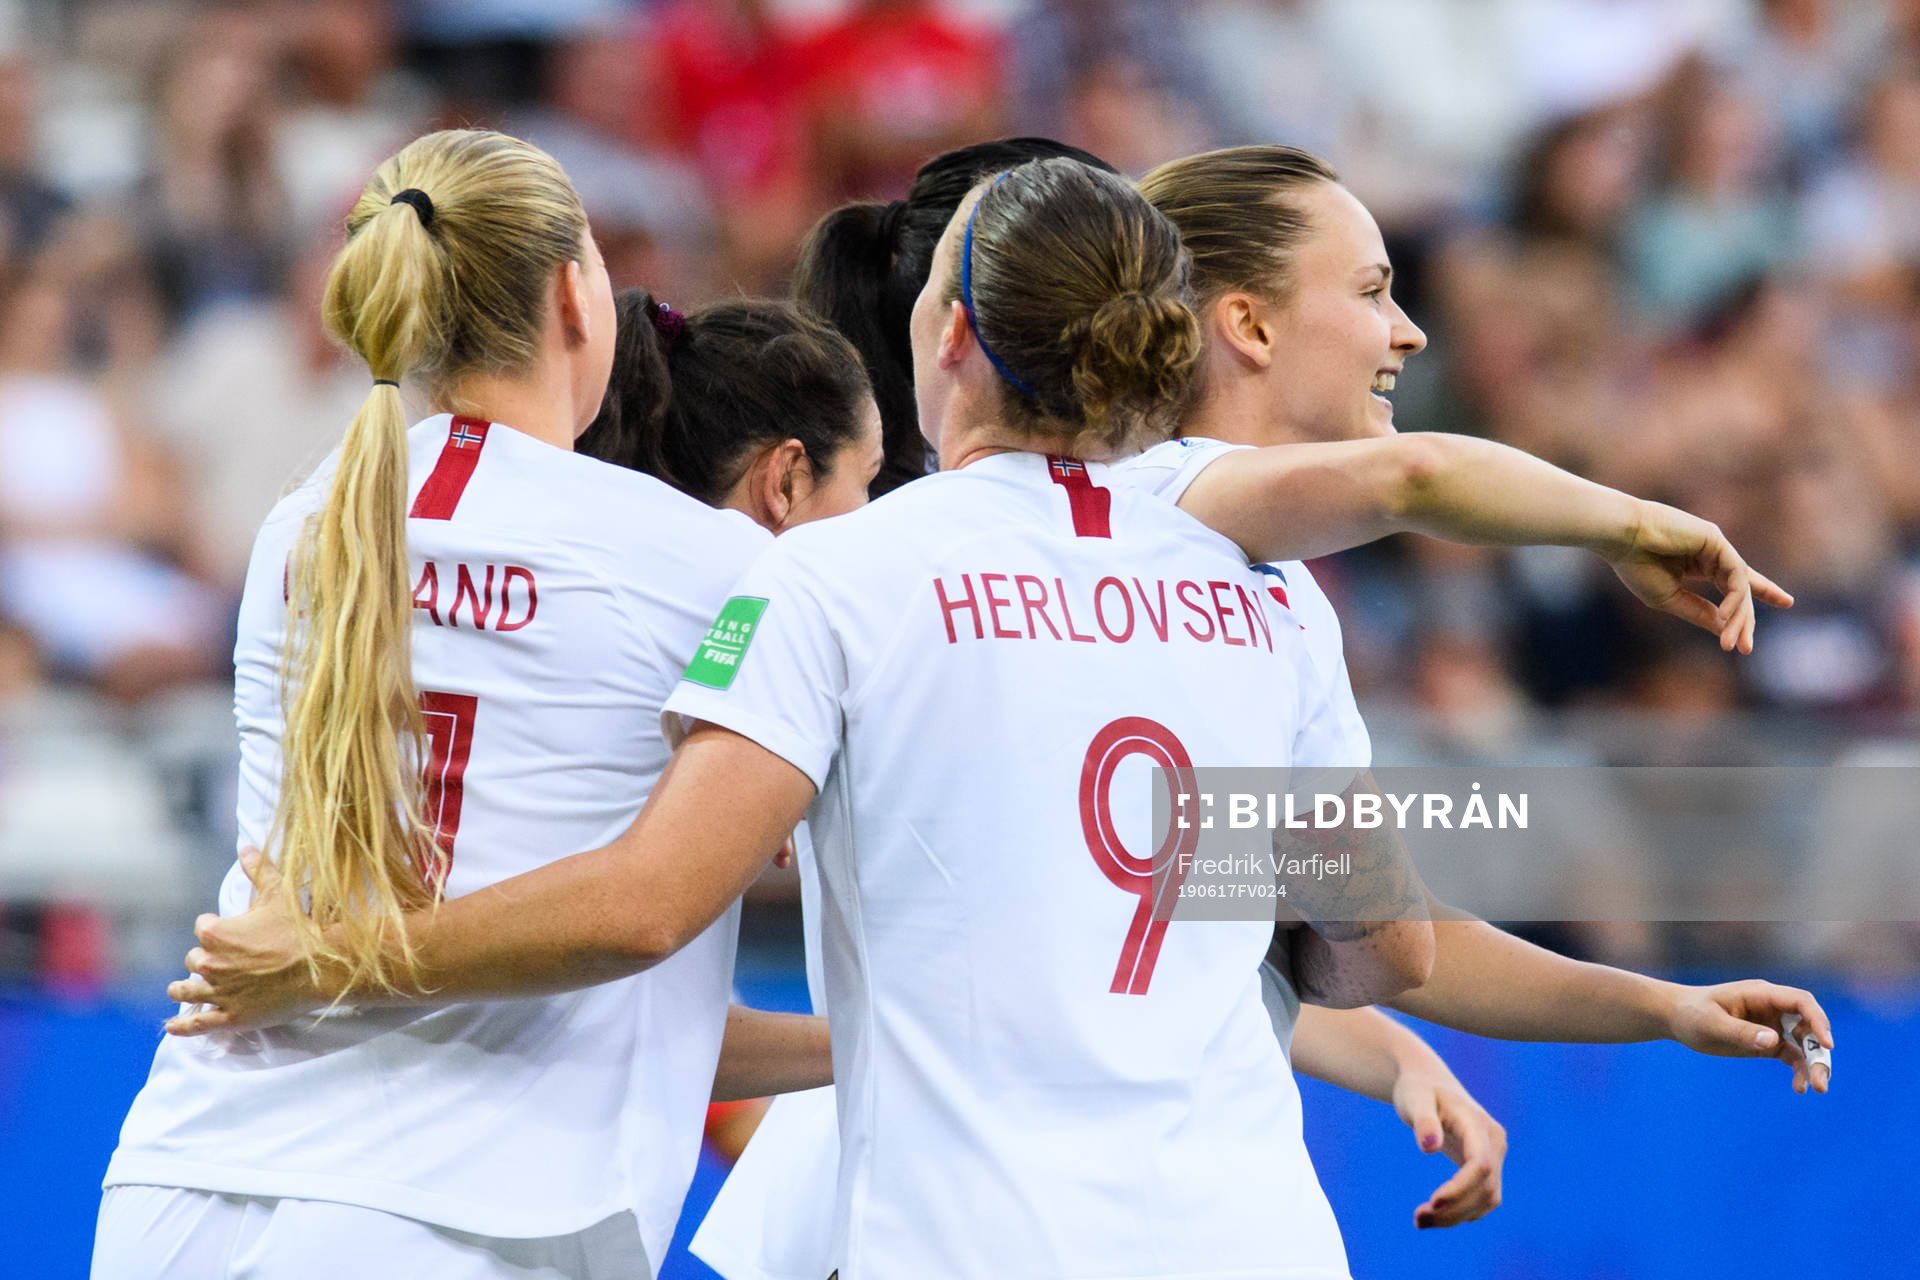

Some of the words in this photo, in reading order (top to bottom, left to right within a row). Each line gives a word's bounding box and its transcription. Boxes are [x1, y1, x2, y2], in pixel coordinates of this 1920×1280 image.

[932, 572, 1274, 654] HERLOVSEN
[703, 648, 740, 667] FIFA
[1078, 715, 1200, 996] 9
